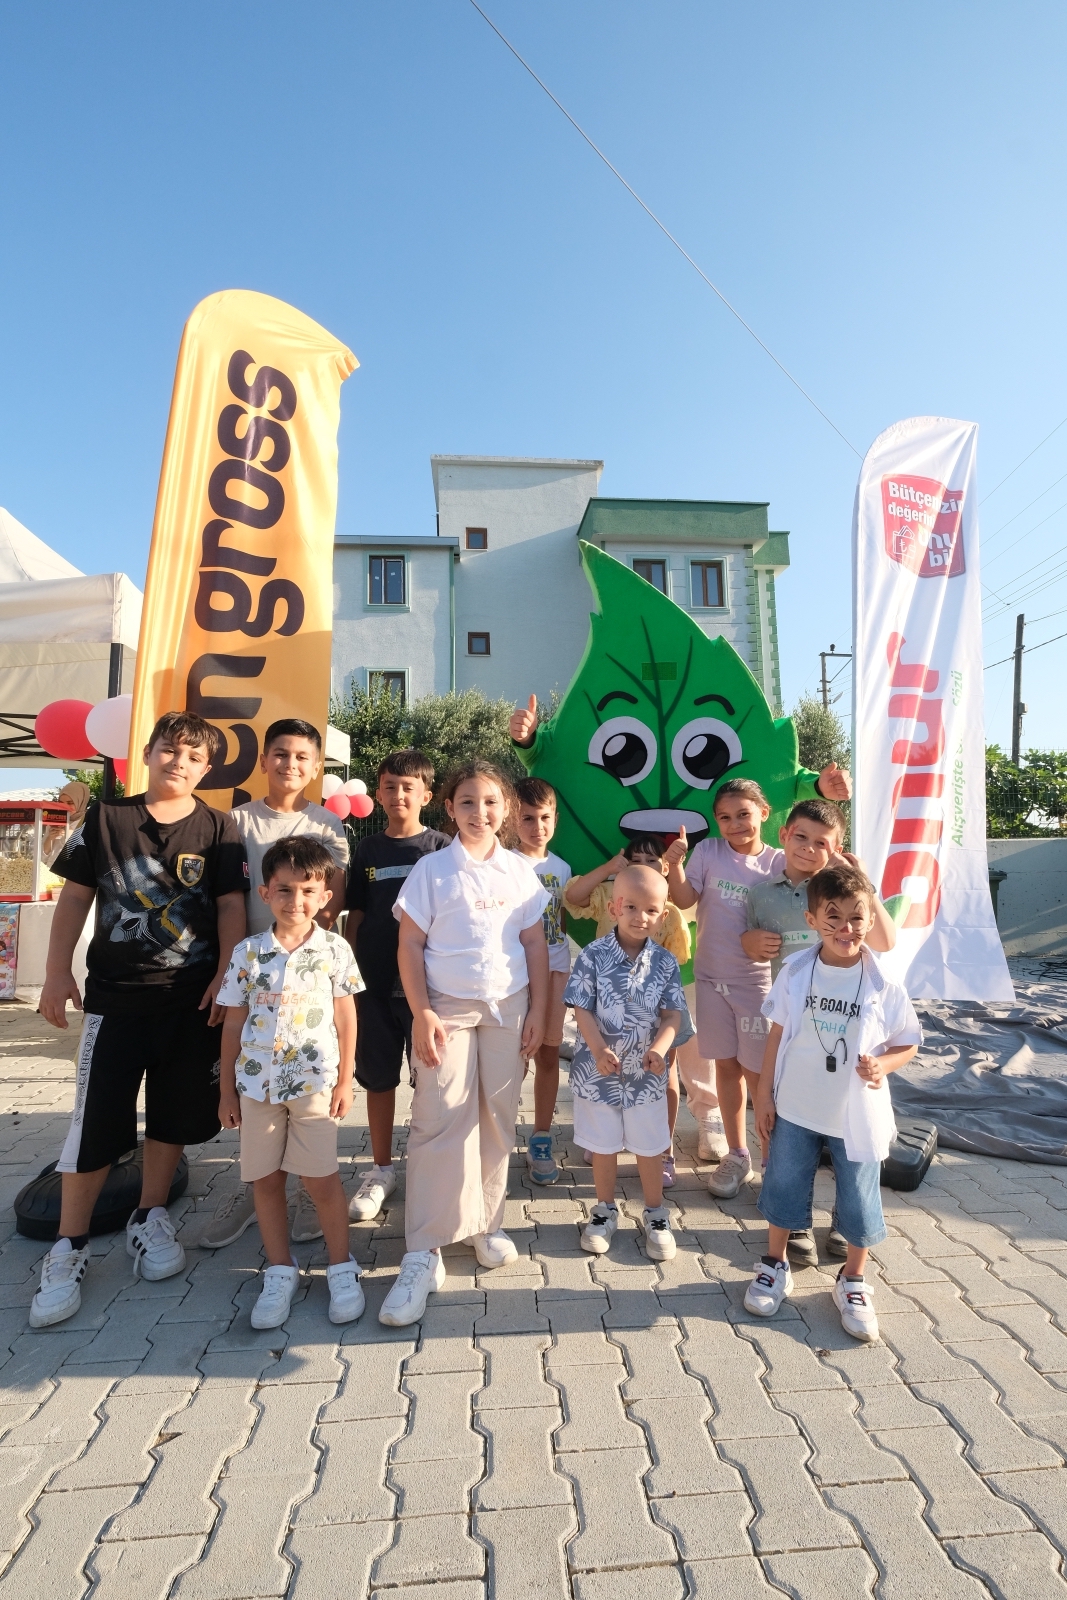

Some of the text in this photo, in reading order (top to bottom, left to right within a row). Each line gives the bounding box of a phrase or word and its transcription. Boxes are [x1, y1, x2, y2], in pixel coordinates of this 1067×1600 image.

[717, 879, 749, 896] RAVZA
[474, 899, 499, 910] ELA
[810, 1018, 847, 1035] TAHA
